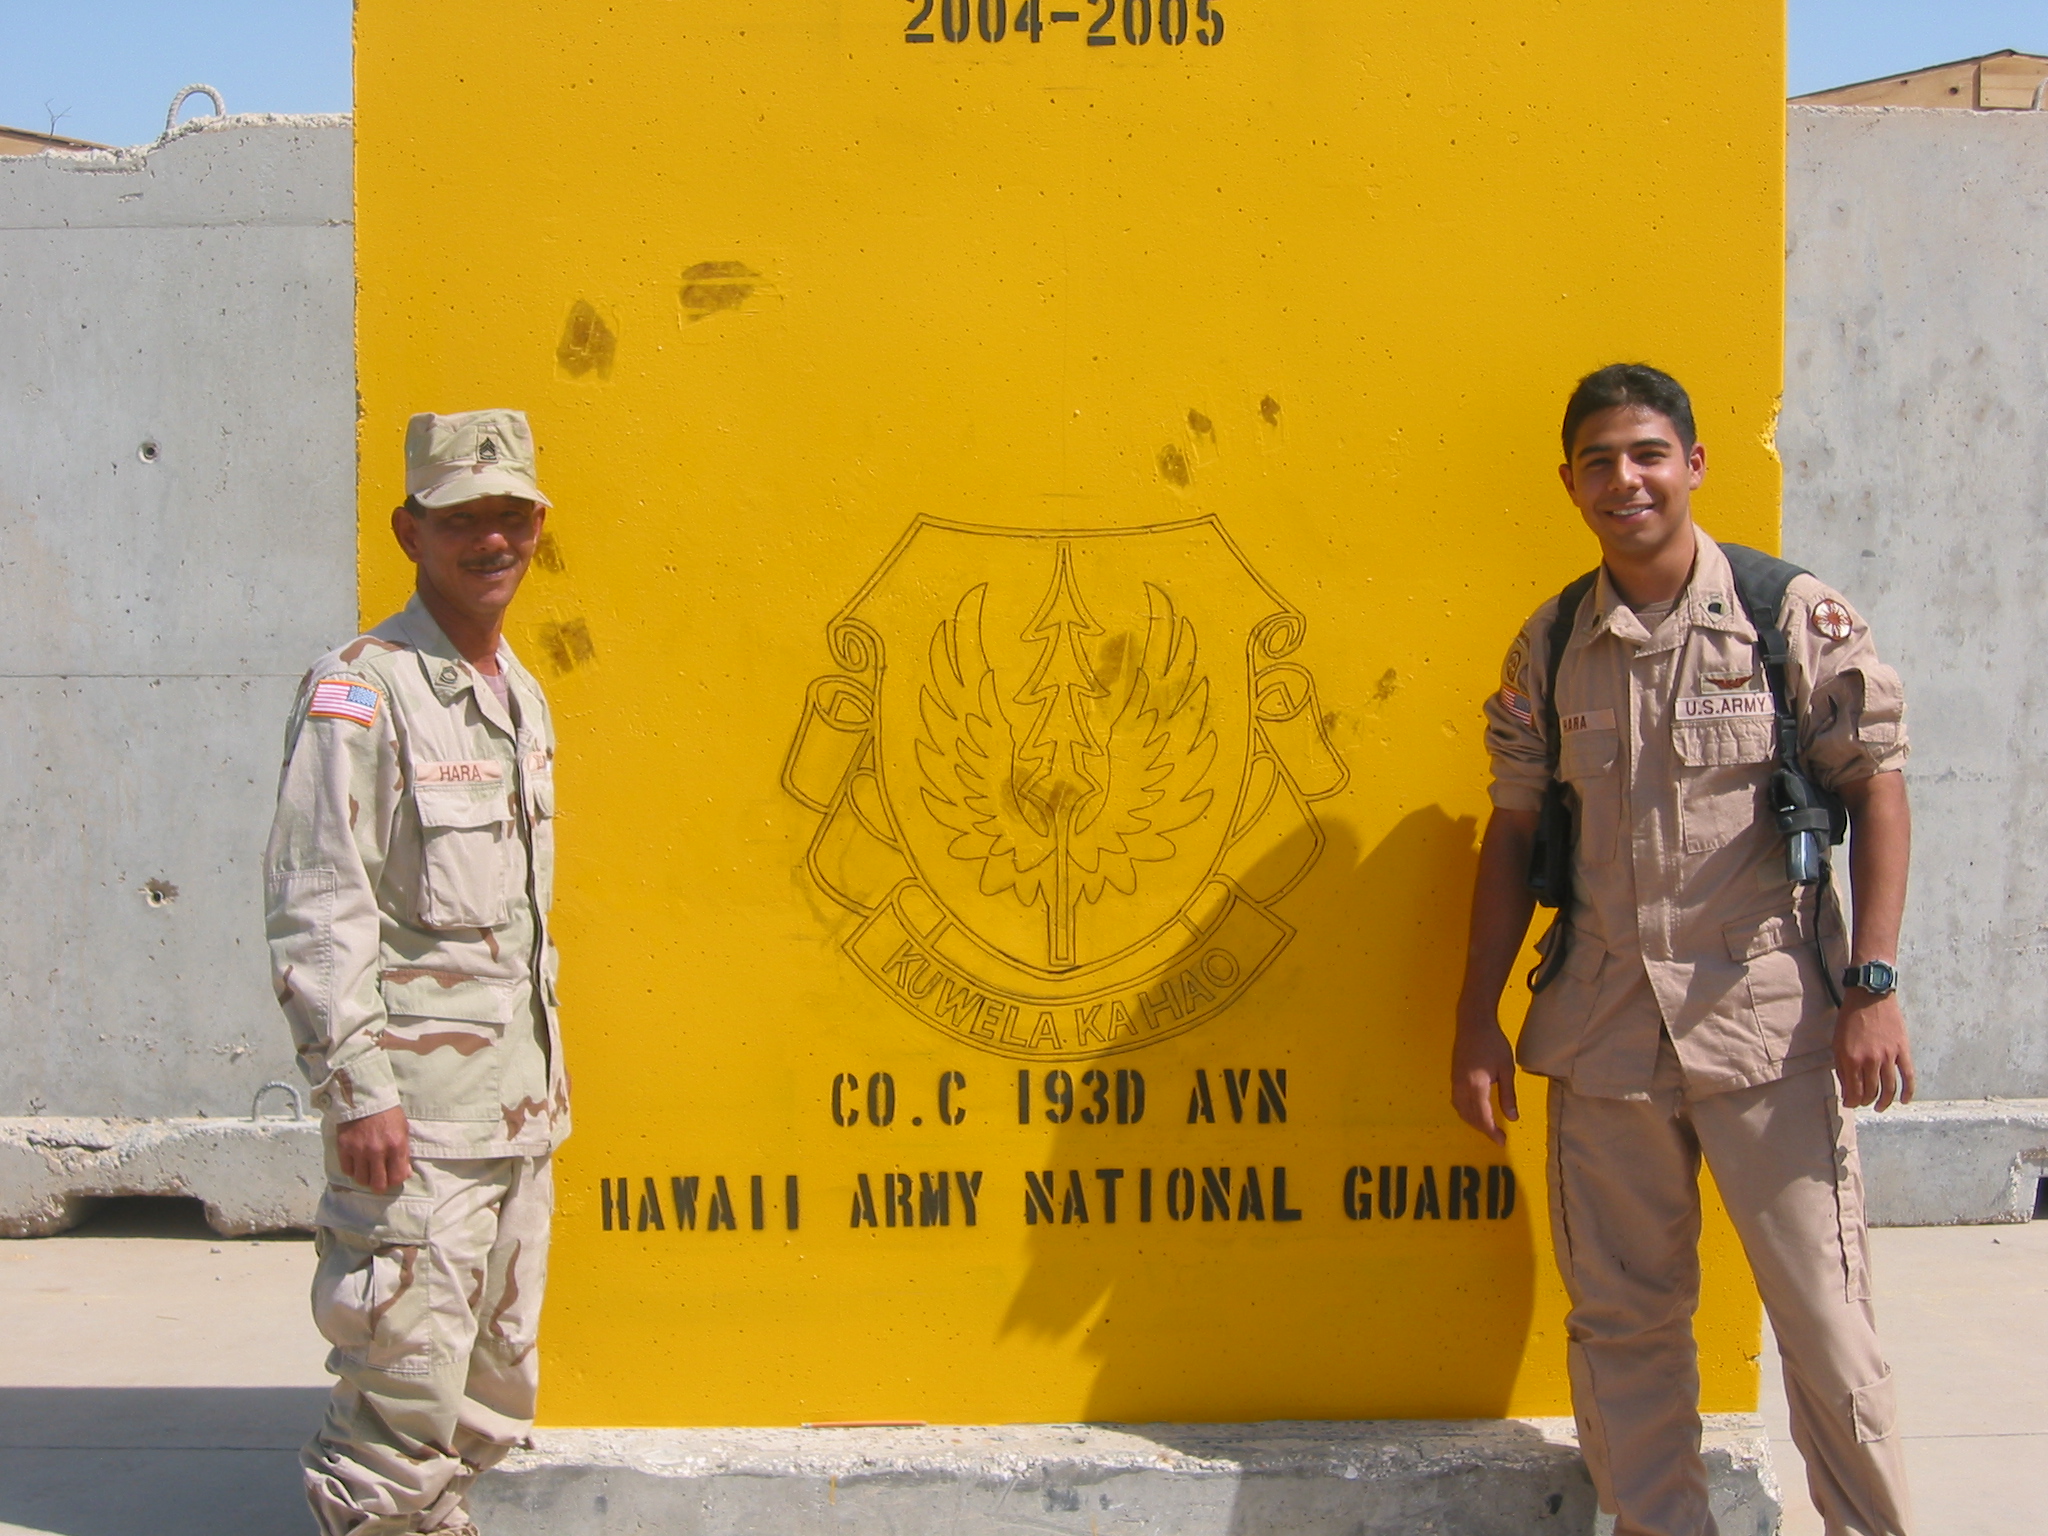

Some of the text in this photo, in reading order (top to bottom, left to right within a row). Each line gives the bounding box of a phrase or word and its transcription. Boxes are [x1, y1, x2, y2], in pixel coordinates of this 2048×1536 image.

[904, 0, 1225, 46] 2004-2005
[439, 764, 482, 782] HARA
[880, 938, 1240, 1050] KUWELA KA HAO
[1018, 1069, 1145, 1125] 193D
[1187, 1068, 1288, 1124] AVN
[601, 1165, 1517, 1232] HAWAII ARMY NATIONAL GUARD
